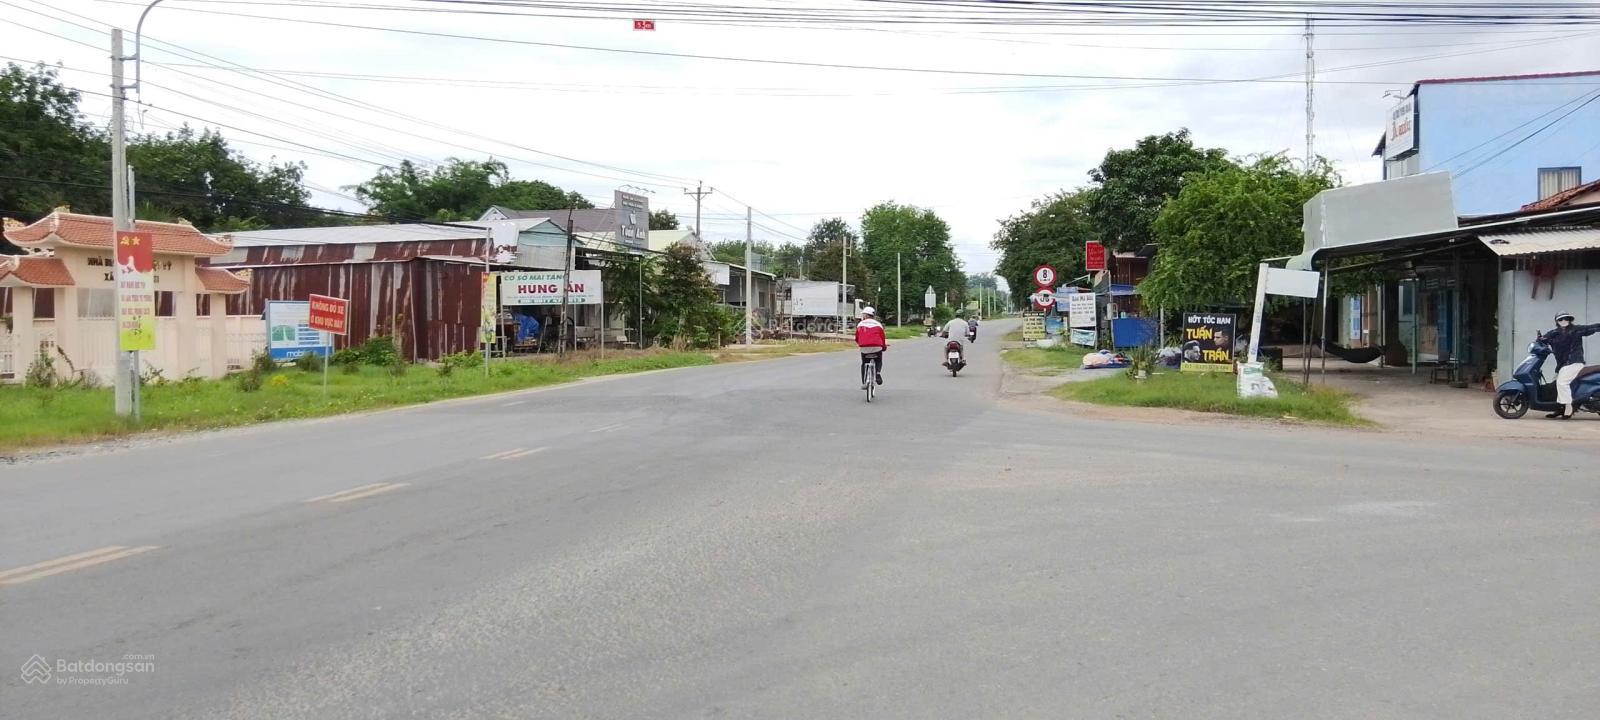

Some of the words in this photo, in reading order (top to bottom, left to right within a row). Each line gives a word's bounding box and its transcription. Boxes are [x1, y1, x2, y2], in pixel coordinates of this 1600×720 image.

[1042, 269, 1048, 279] 8
[312, 300, 329, 312] KHÔNG
[337, 304, 345, 315] XE
[315, 315, 325, 326] KHU
[1202, 314, 1215, 324] TÓC
